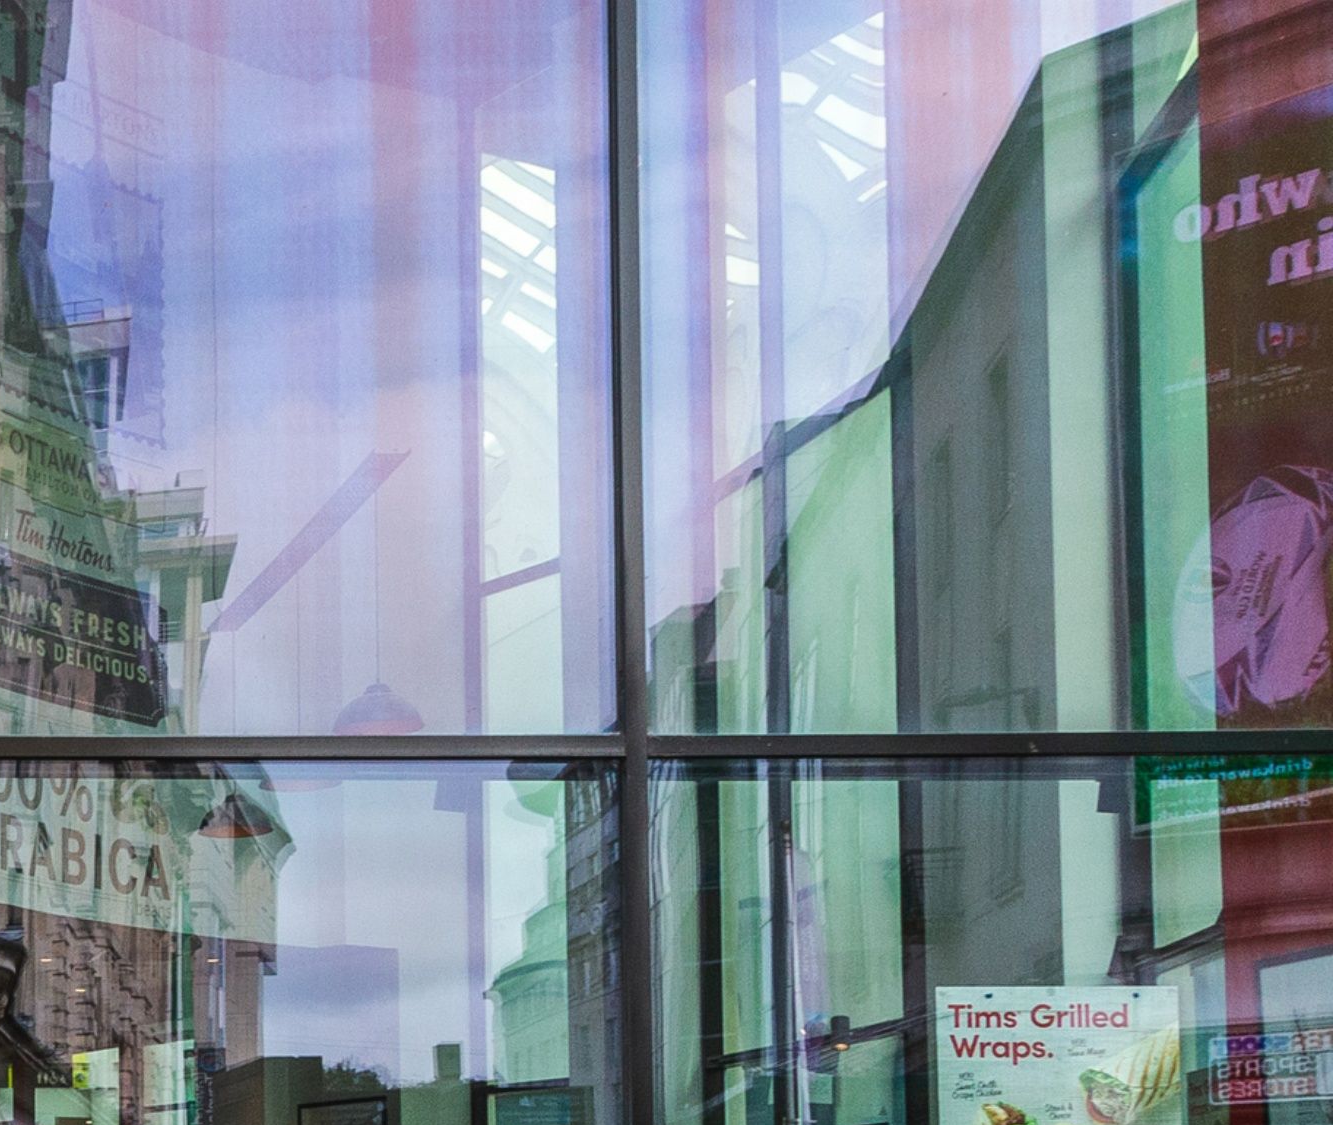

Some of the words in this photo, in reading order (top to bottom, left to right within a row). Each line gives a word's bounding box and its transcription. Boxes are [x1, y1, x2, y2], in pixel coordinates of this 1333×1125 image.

[16, 508, 44, 549] Tim
[1030, 1003, 1129, 1029] Grilled
[949, 1034, 1054, 1066] Wraps.
